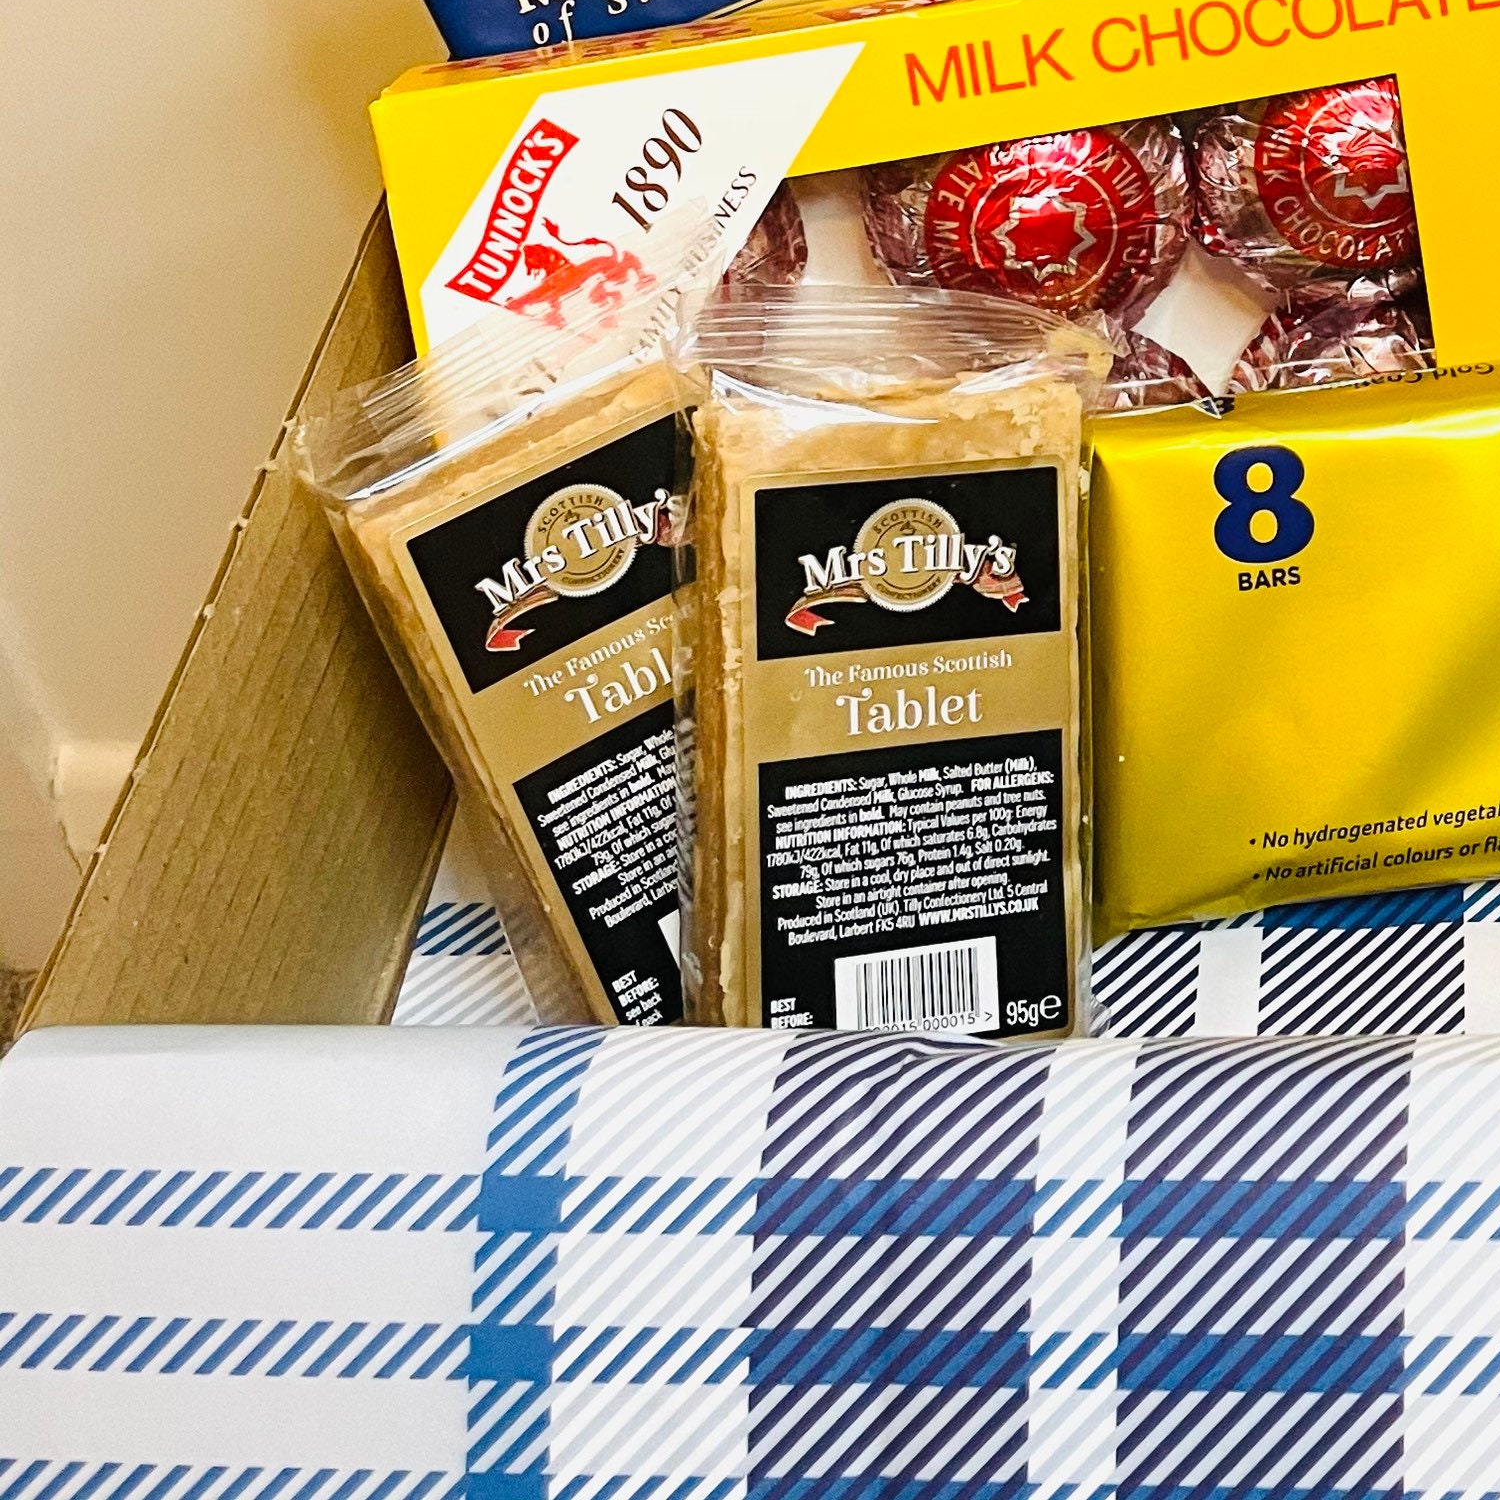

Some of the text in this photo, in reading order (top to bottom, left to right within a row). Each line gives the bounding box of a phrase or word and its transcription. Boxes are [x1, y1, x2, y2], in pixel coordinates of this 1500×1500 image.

[532, 0, 576, 47] of
[903, 27, 1075, 108] MILK
[611, 108, 702, 234] 1890
[459, 129, 565, 296] TUNNOCK'S
[1273, 196, 1406, 262] CHOCOLAT
[1433, 363, 1493, 381] Gold
[537, 492, 605, 534] SCOTTISH
[873, 509, 944, 535] SCOTTISH
[1213, 444, 1315, 564] 8
[475, 543, 567, 617] Mrs
[797, 534, 1016, 595] Mrs Tilly's
[1237, 566, 1302, 592] BARS
[523, 628, 646, 697] The Famous
[564, 647, 674, 725] Tabl
[804, 649, 1013, 689] The Famous Scottish
[835, 686, 984, 737] Tablet
[767, 770, 1055, 819] Sweetened Condensed Glucose FOR ALLERGENS:
[785, 778, 857, 800] INGREDIENTS:
[943, 763, 972, 779] Salted
[974, 762, 1003, 777] Butter
[775, 804, 1048, 851] NUTRITION INFORMATION: Energy
[1262, 831, 1290, 850] No
[1292, 810, 1428, 848] hydrogenated
[1265, 864, 1293, 882] No
[1295, 852, 1378, 879] artificial
[1382, 840, 1454, 866] colours
[1459, 840, 1481, 857] or
[772, 879, 824, 901] STORAGE:
[918, 896, 1040, 927] WWW.MRSTILLYS.CO.UK
[923, 890, 987, 910] Confectionery
[770, 997, 797, 1015] BEST
